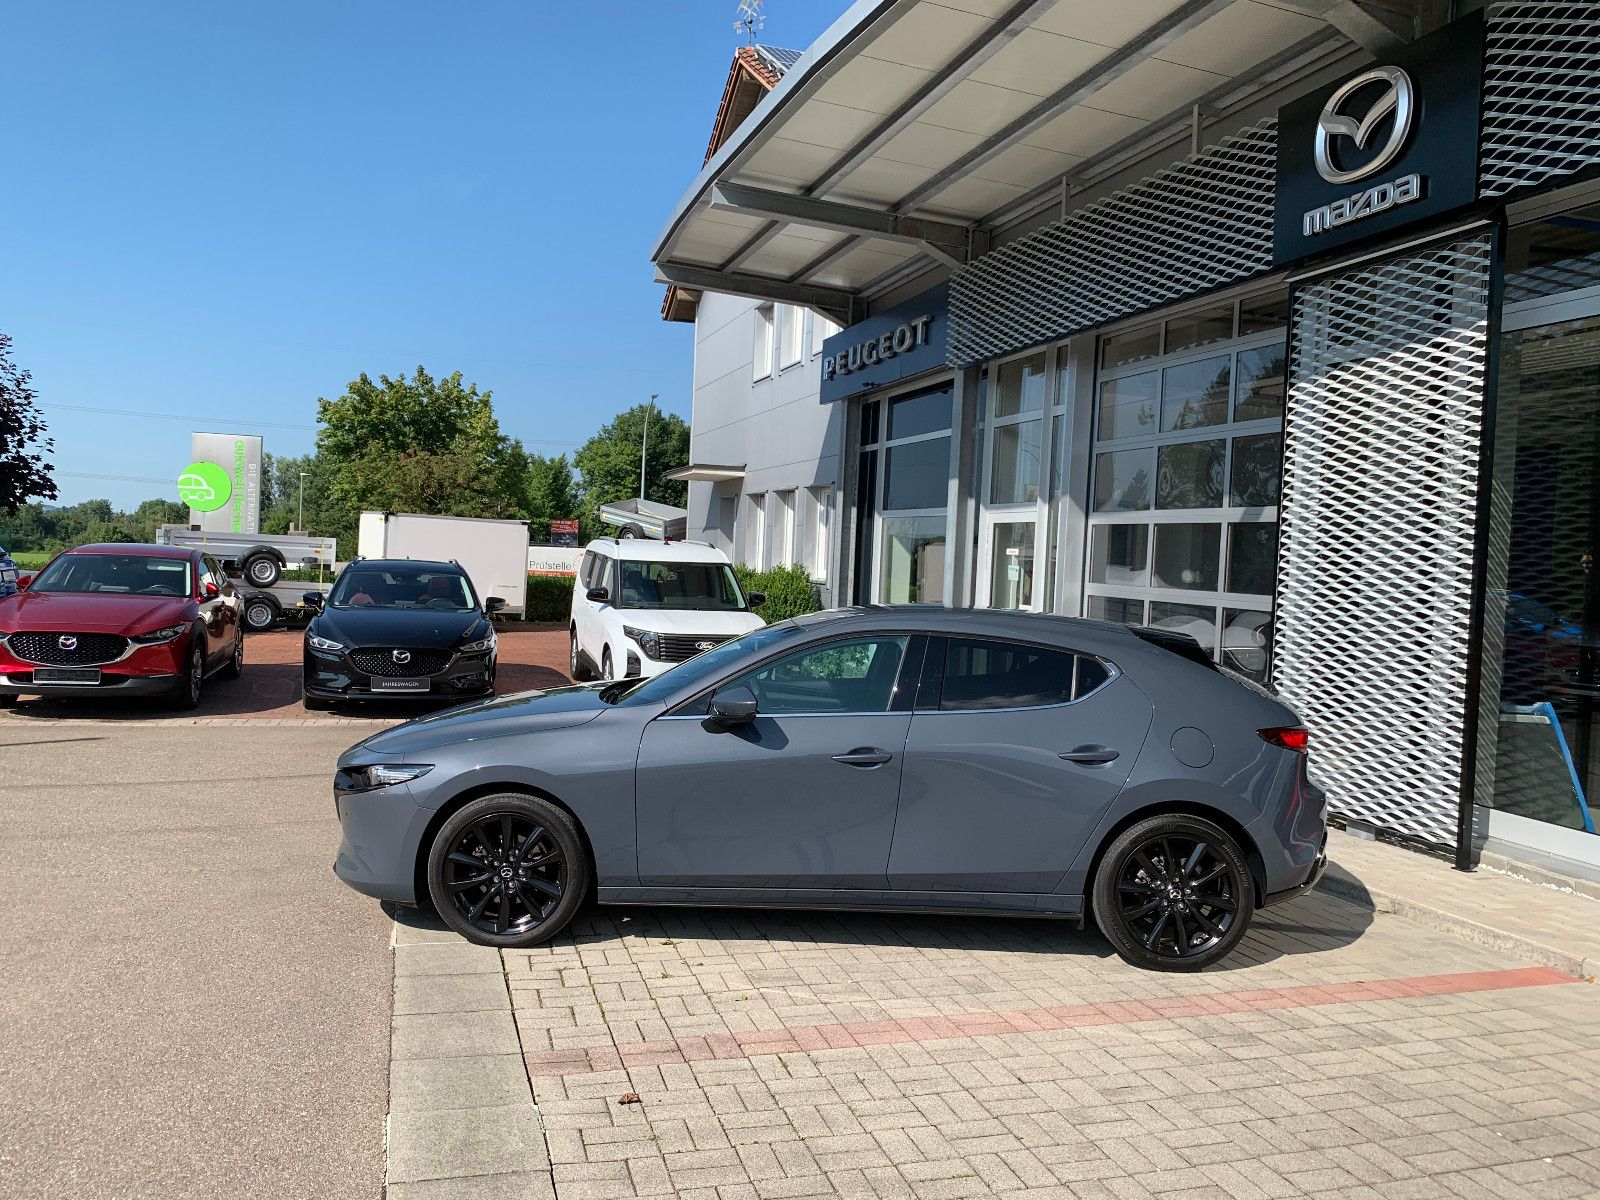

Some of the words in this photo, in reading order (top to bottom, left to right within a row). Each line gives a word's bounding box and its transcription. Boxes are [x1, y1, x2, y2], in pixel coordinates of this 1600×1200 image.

[1303, 173, 1420, 236] mazda
[823, 314, 932, 380] PEUGEOT
[248, 463, 256, 478] DIE
